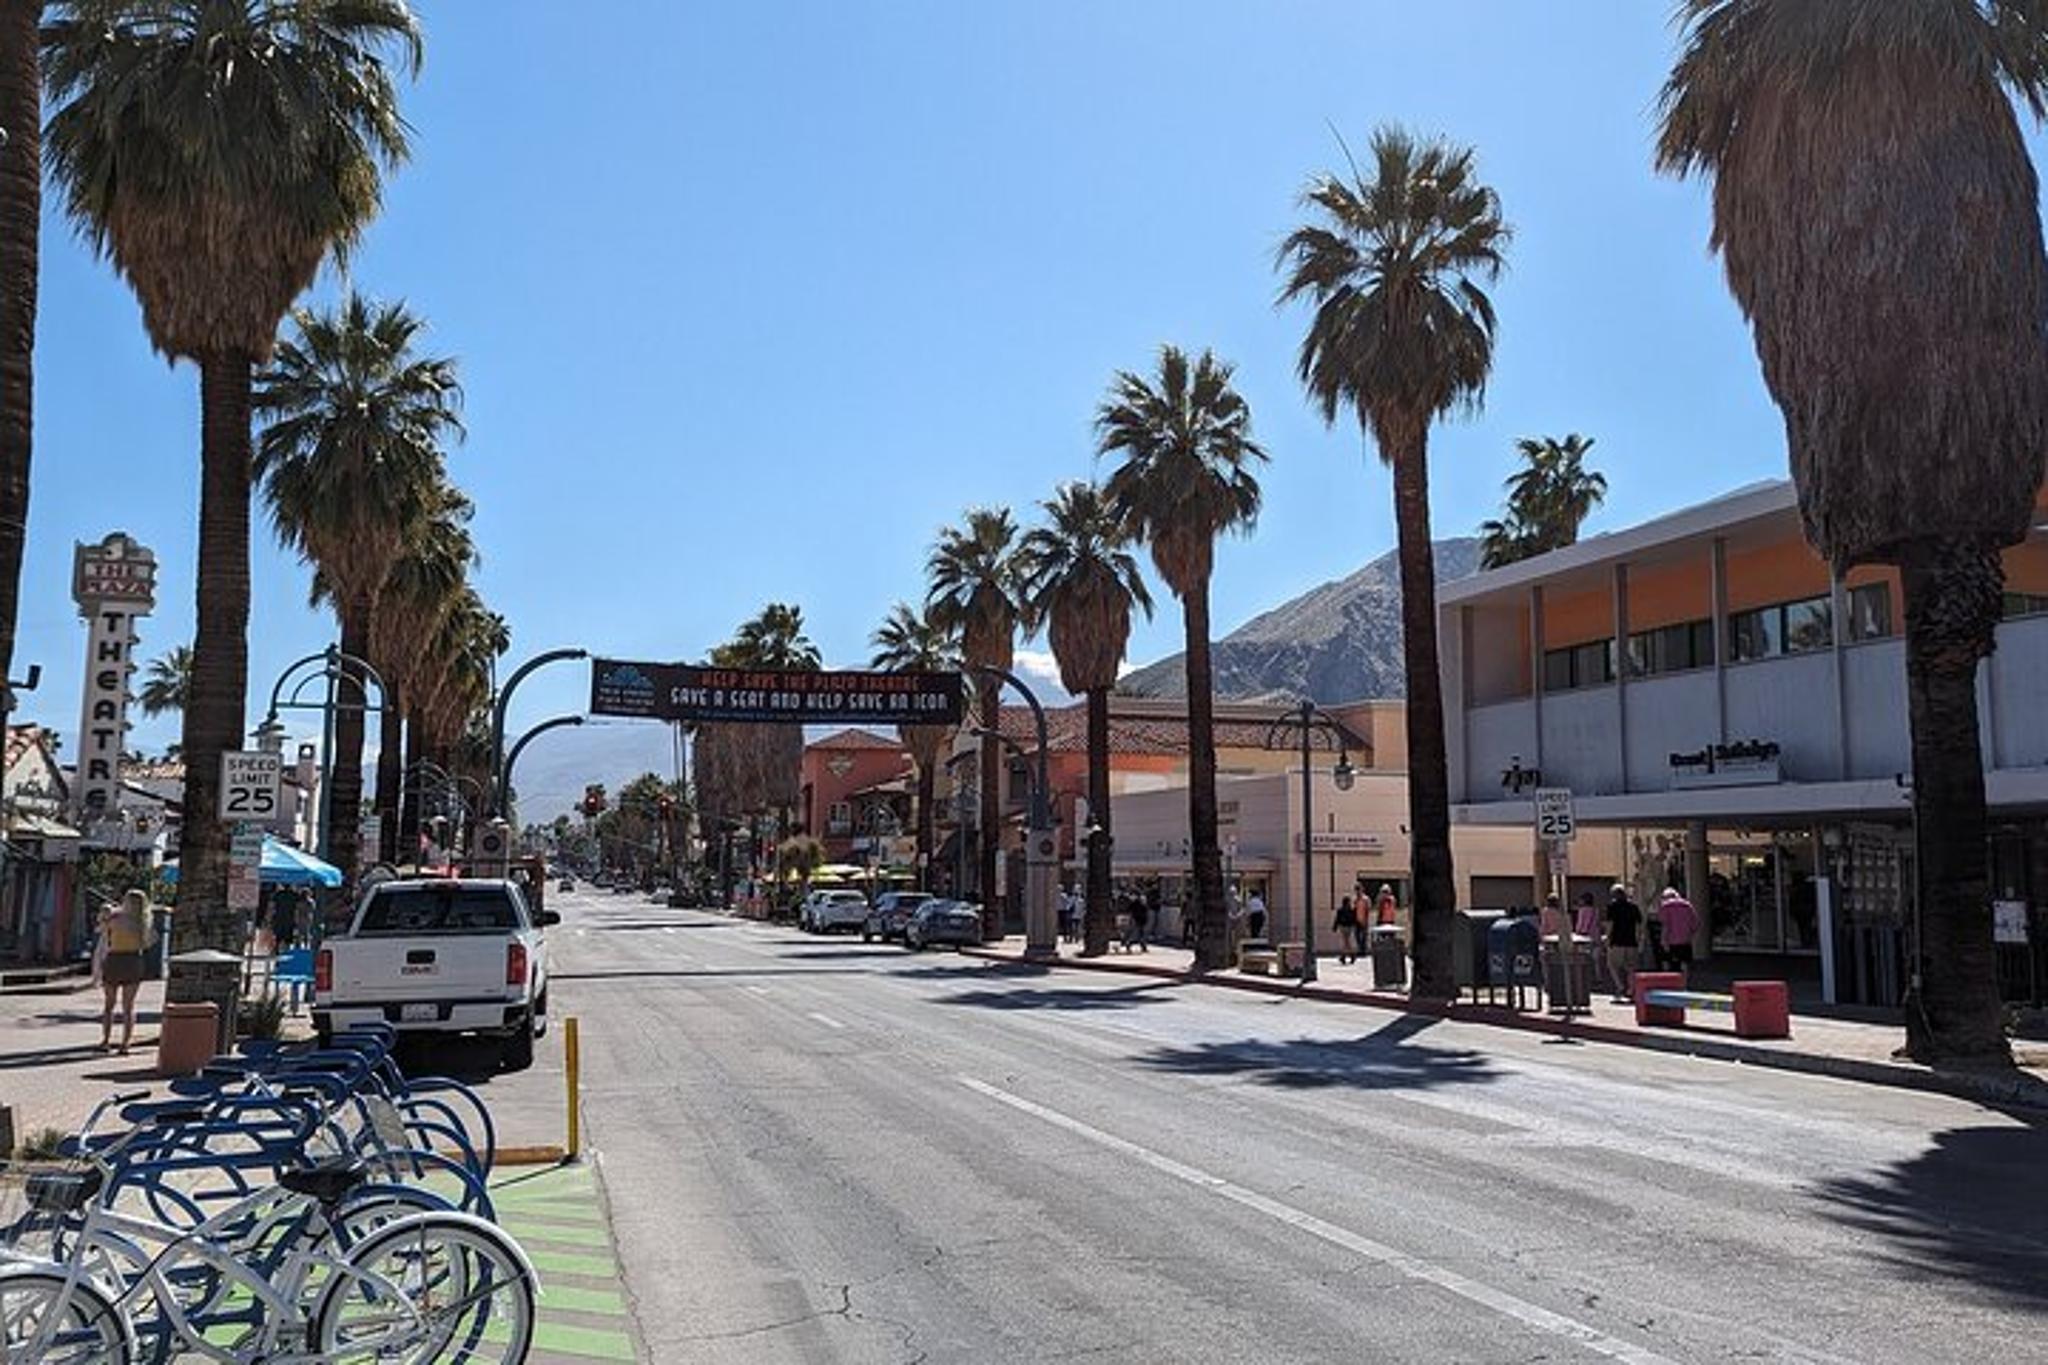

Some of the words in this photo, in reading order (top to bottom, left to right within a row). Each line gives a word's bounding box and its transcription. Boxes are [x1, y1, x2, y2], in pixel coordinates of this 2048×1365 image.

[93, 564, 134, 578] THE
[670, 686, 707, 706] SAVE
[713, 690, 723, 707] A
[730, 689, 764, 708] SEAT
[770, 692, 800, 709] AND
[807, 693, 844, 709] HELP
[849, 693, 884, 710] SAVE
[889, 693, 909, 710] AN
[913, 693, 948, 711] ICON
[86, 611, 125, 809] THEATRE
[228, 759, 277, 771] SPEED
[231, 774, 271, 785] LIMIT
[227, 787, 274, 813] 25
[1541, 815, 1571, 835] 25
